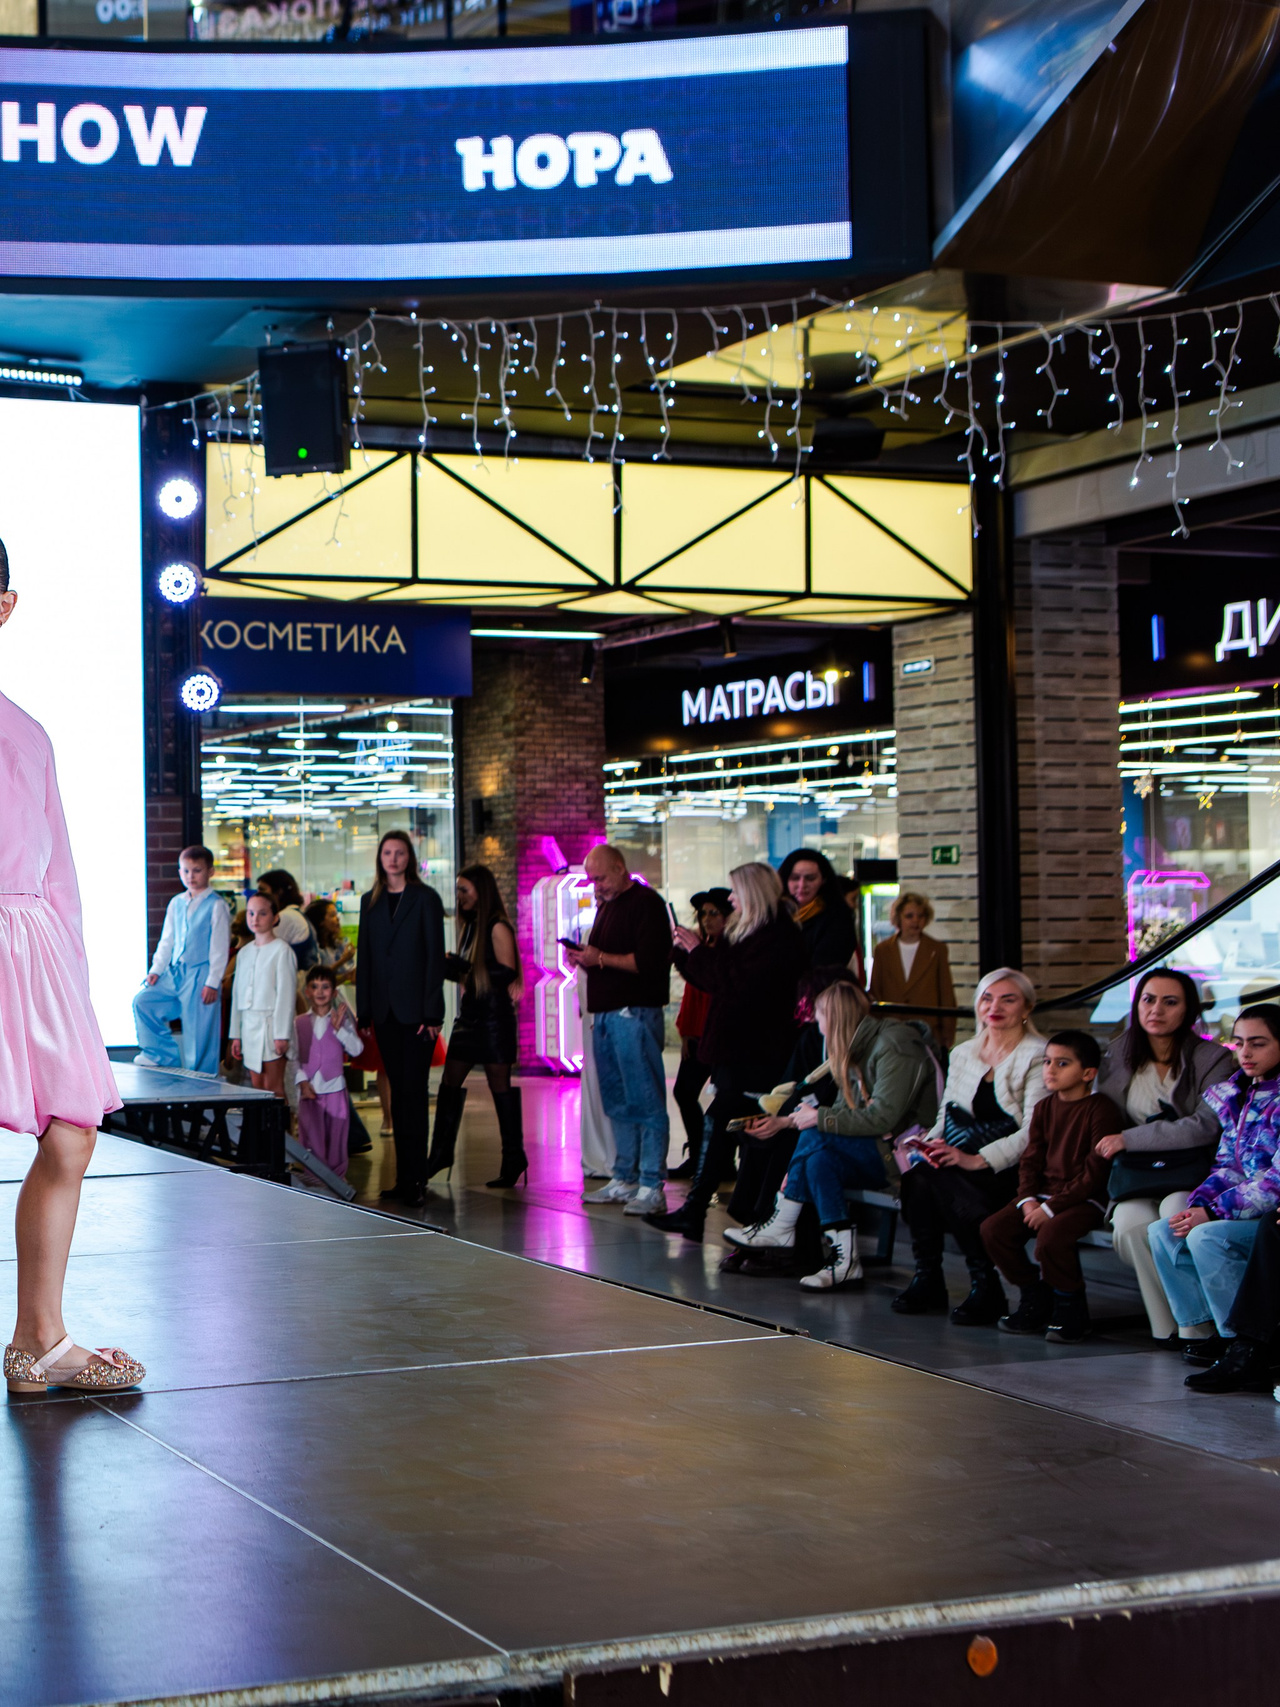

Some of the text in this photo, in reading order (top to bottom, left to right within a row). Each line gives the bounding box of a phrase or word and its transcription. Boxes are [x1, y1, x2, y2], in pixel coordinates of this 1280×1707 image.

[455, 128, 673, 192] НОРА
[200, 620, 407, 654] КОСМЕТИКА
[682, 670, 836, 726] МАТРАСЫ
